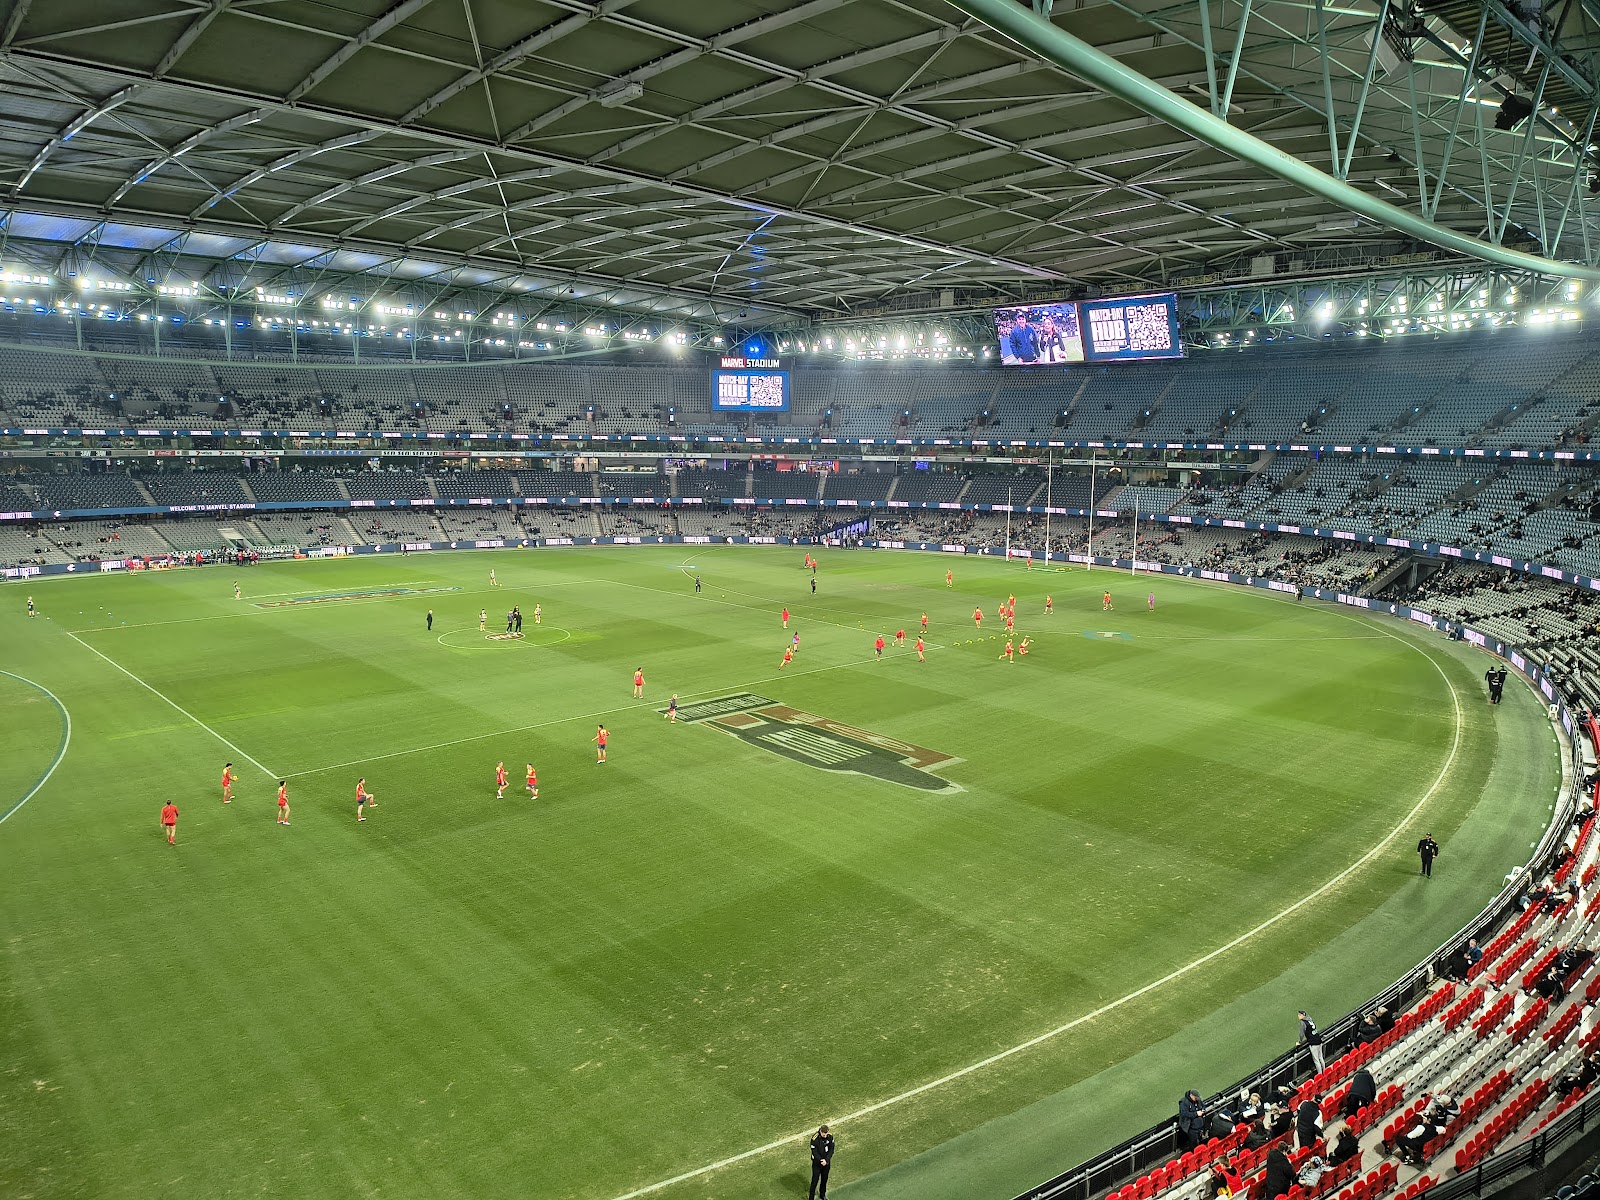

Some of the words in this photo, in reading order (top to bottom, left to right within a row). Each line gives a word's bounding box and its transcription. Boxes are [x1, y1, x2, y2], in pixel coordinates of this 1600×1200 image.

[1091, 320, 1126, 341] HUB
[722, 358, 745, 368] MARVEL
[746, 359, 780, 368] STADIUM
[719, 384, 748, 397] HUB
